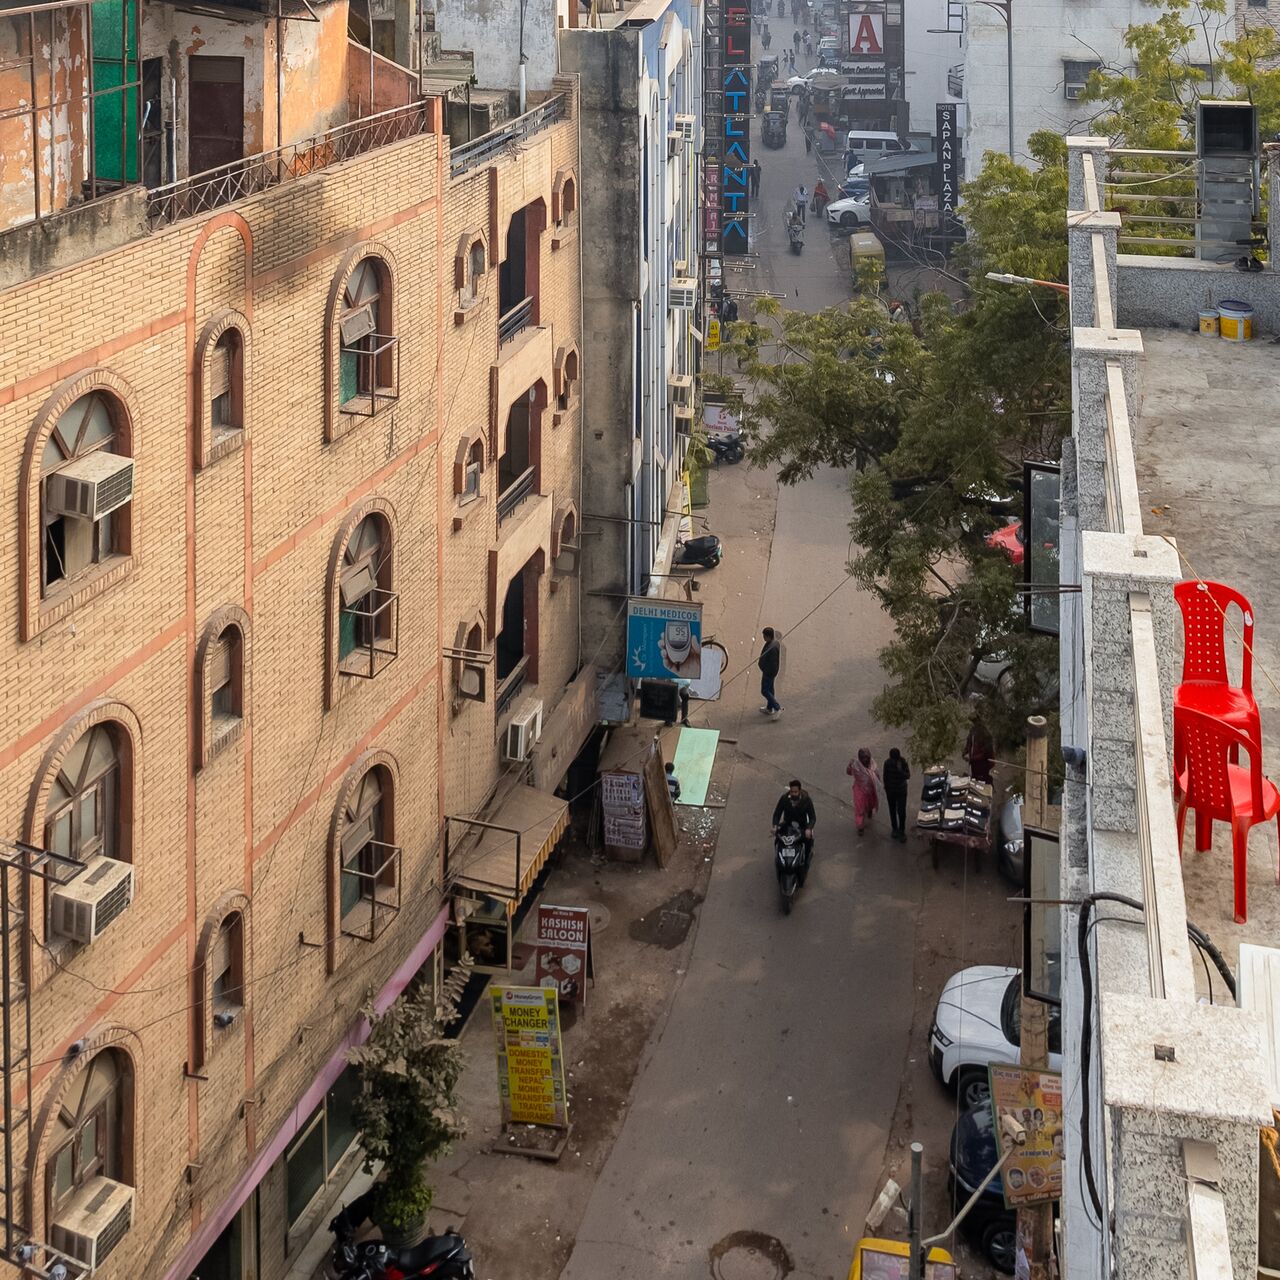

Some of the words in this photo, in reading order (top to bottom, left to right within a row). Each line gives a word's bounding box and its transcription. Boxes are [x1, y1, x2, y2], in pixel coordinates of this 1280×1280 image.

[942, 112, 952, 159] SAPAN
[722, 67, 749, 237] ATLANTA
[943, 163, 952, 211] PLAZA
[633, 606, 657, 617] DELHI
[659, 608, 698, 620] MEDICOS
[541, 917, 584, 930] KASHISH
[541, 928, 584, 942] SALOON
[509, 1007, 541, 1017] MONEY
[505, 1017, 548, 1029] CHANGER
[509, 1049, 549, 1058] DOMESTIC
[516, 1058, 543, 1067] MONEY
[510, 1067, 551, 1076] TRANSFER
[519, 1076, 545, 1085] NEPAL
[518, 1084, 545, 1094] MONEY
[512, 1093, 553, 1103] TRANSFER
[519, 1102, 549, 1111] TRAVEL
